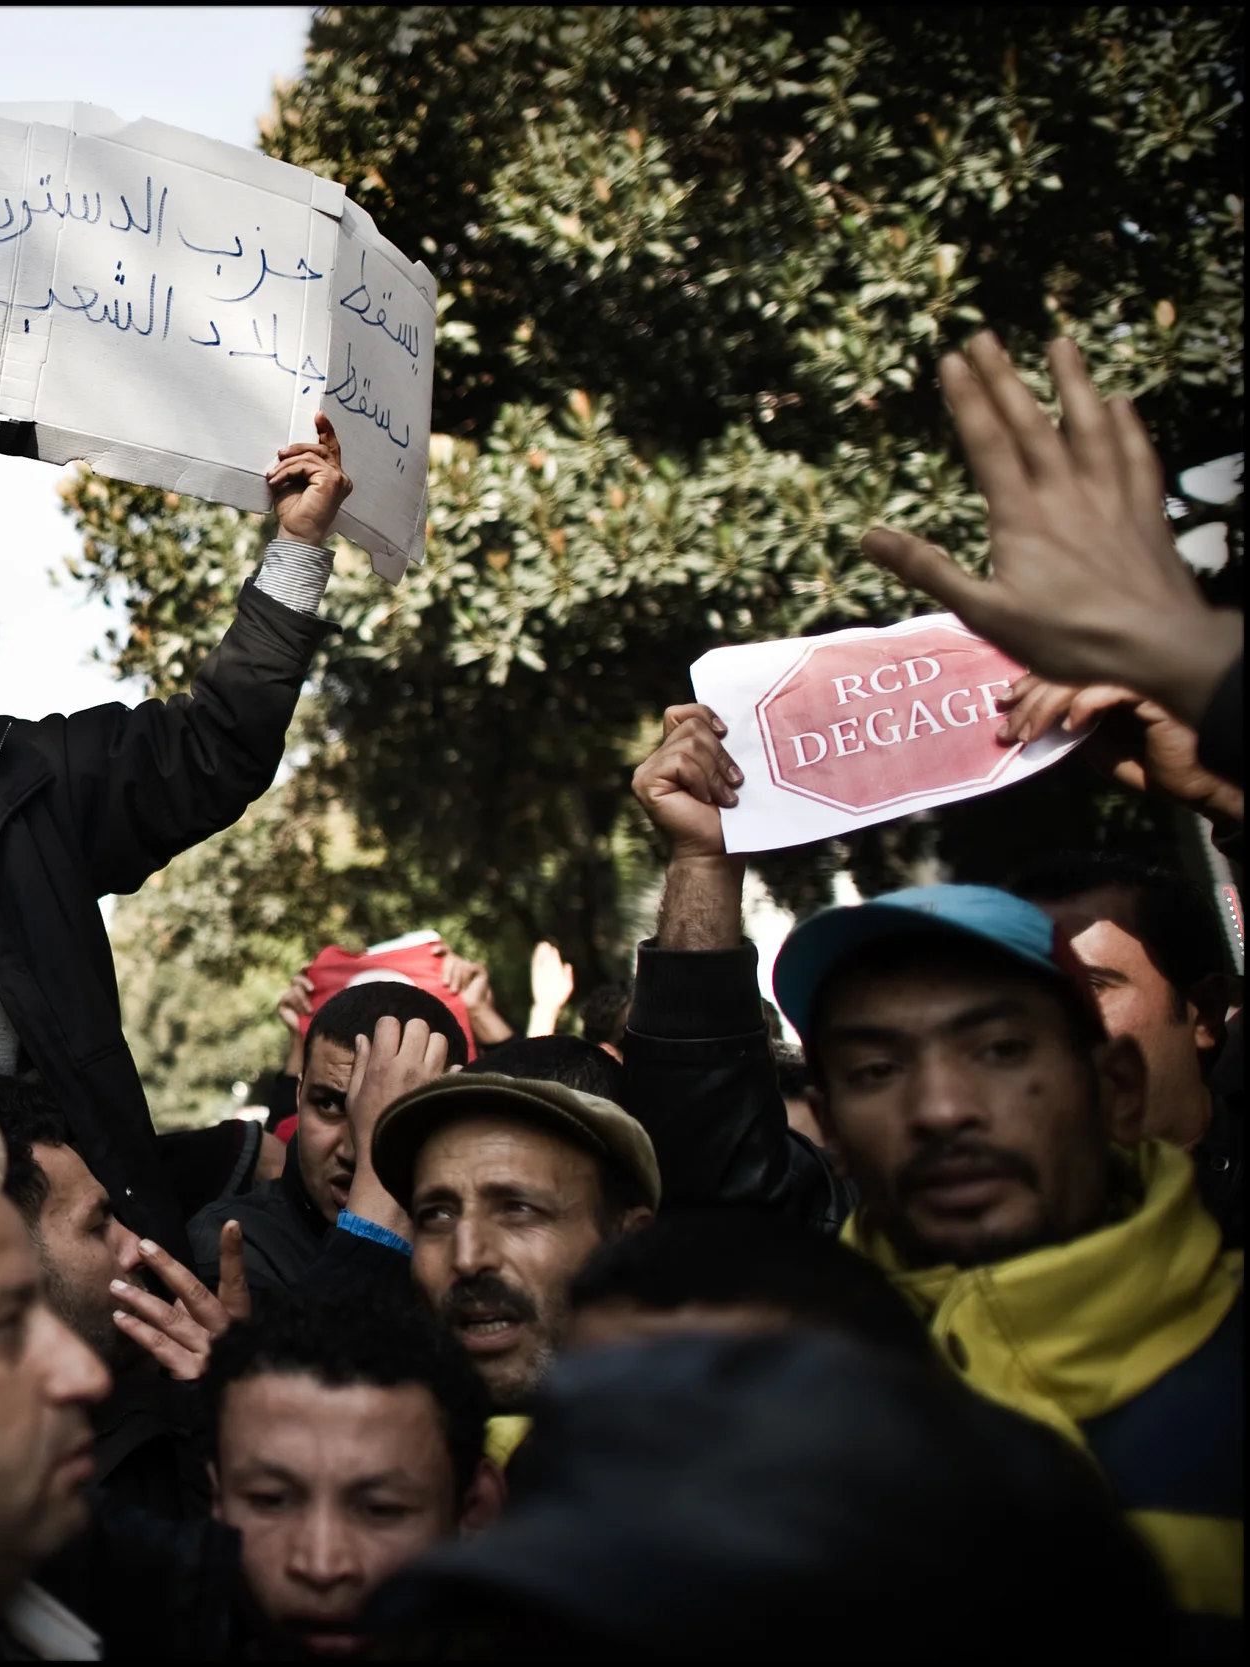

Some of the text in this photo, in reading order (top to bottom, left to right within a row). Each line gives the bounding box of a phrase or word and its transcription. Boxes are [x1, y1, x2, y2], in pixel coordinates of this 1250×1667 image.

[177, 226, 323, 302] حزب
[340, 250, 419, 375] يسقط
[188, 313, 326, 395] جلاد
[321, 342, 410, 473] يسقط
[832, 656, 942, 706] RCD
